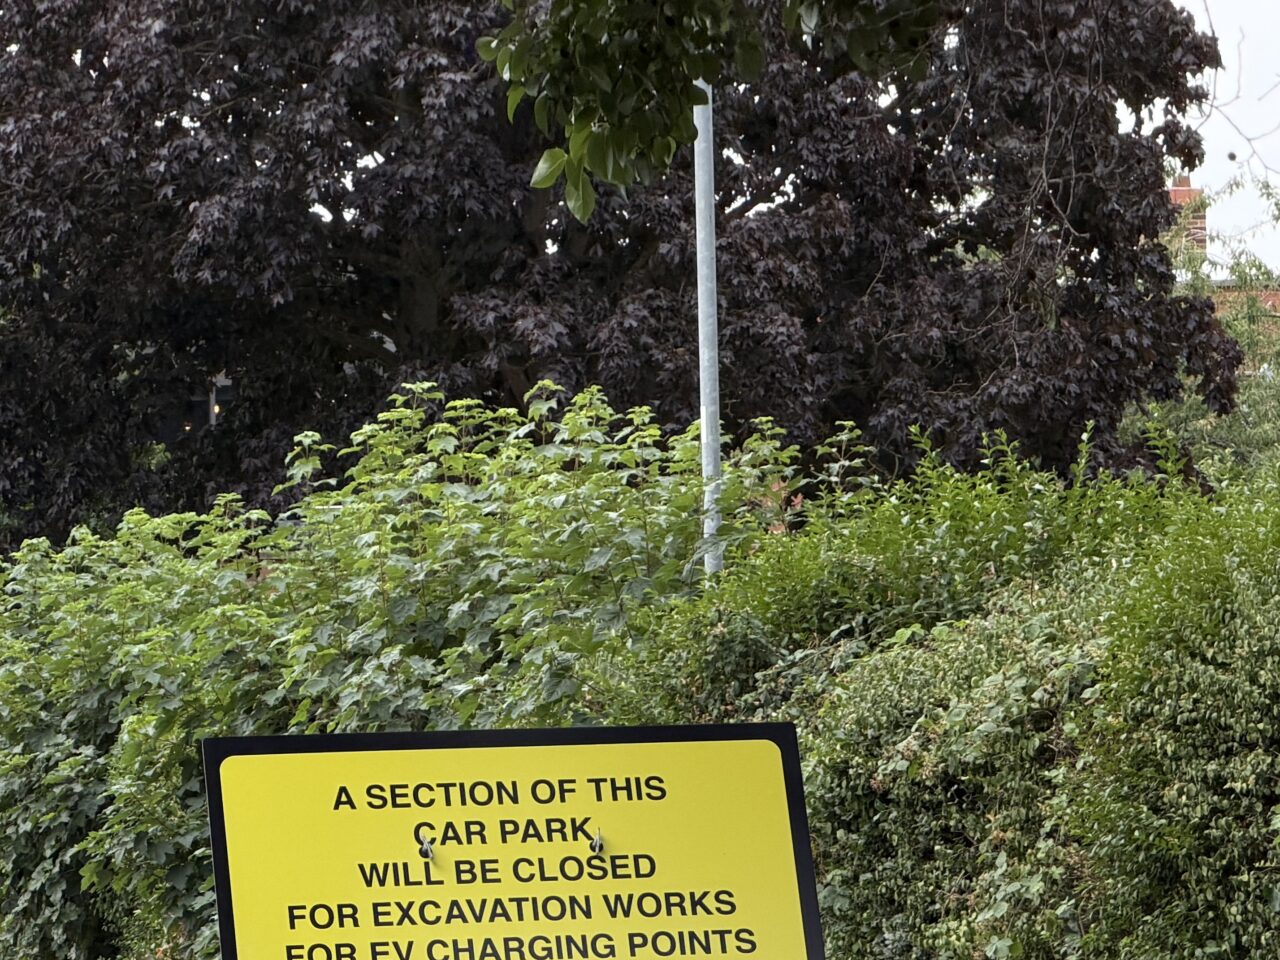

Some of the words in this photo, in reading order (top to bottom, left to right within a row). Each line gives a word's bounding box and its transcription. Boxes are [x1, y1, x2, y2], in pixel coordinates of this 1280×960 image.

[333, 785, 357, 811] A
[365, 780, 520, 810] SECTION
[530, 778, 577, 805] OF
[586, 775, 667, 802] THIS
[413, 821, 488, 847] CAR
[499, 817, 593, 844] PARK
[357, 860, 445, 888] WILL
[454, 858, 502, 885] BE
[512, 853, 657, 883] CLOSED
[287, 903, 360, 930] FOR
[371, 895, 593, 927] EXCAVATION
[601, 889, 737, 919] WORKS
[627, 928, 757, 958] POINTS
